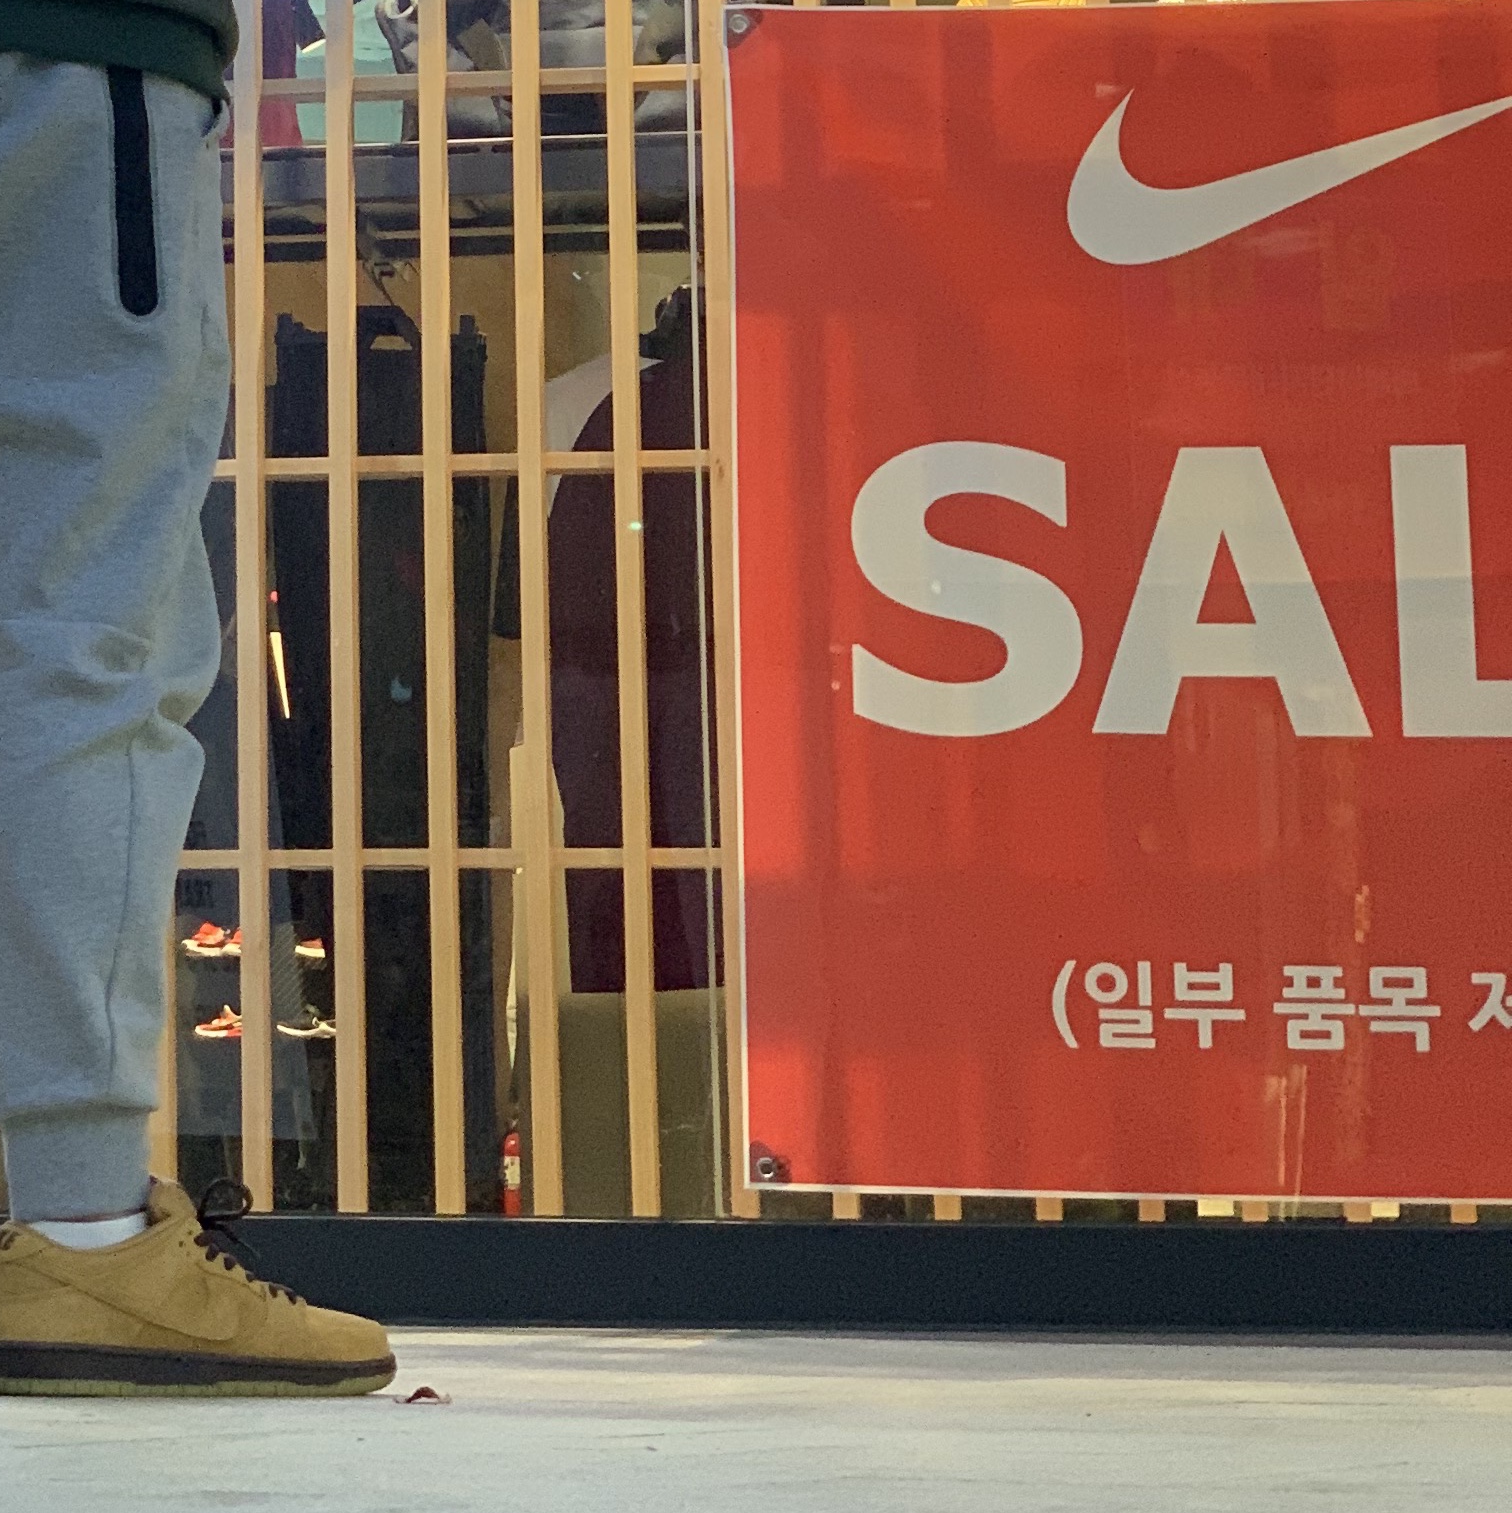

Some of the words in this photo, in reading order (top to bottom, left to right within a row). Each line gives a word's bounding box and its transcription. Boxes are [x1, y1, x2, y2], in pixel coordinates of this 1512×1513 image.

[850, 440, 1512, 737] SAL
[1052, 960, 1246, 1049] (일부
[1273, 965, 1441, 1052] 품목
